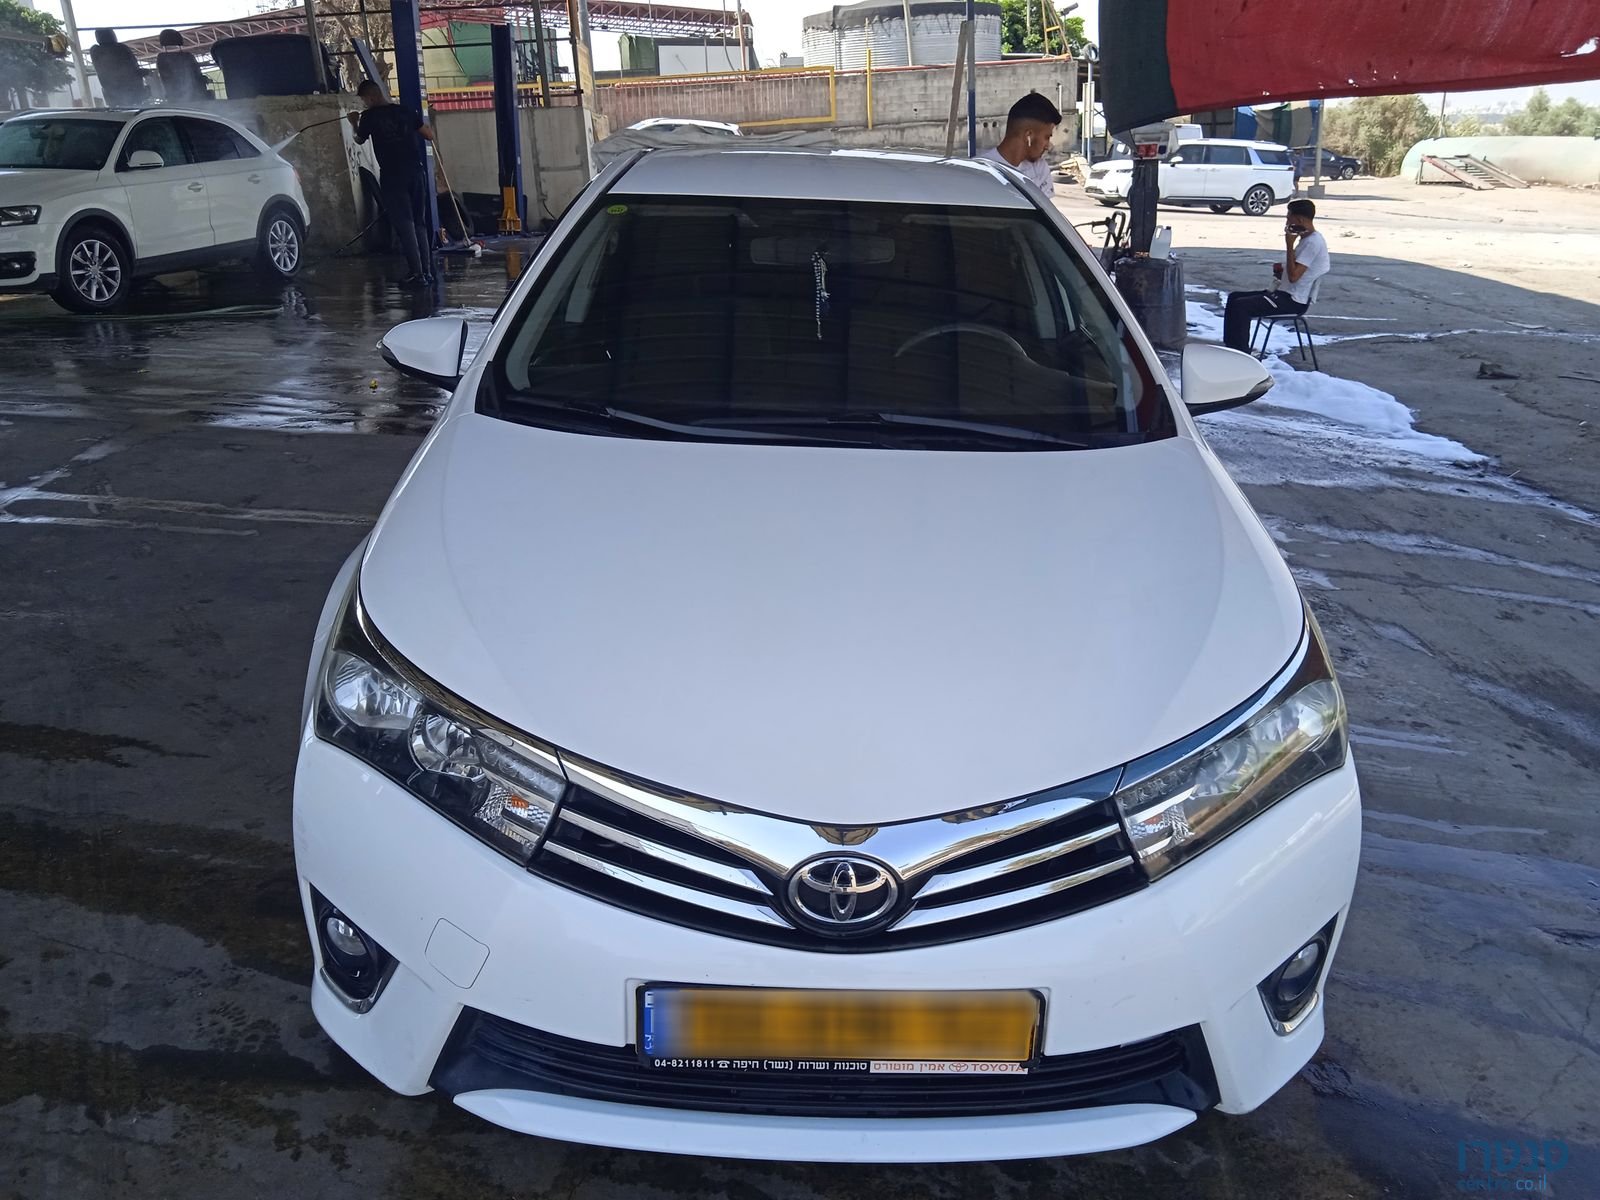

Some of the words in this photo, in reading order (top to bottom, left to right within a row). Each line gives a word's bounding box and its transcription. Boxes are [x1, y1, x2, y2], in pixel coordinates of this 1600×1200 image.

[654, 1058, 715, 1068] 04-8211811
[732, 1059, 759, 1071] חיפה
[797, 1061, 830, 1070] ושרות
[833, 1061, 868, 1071] סוכנות
[873, 1062, 914, 1071] מוטורס
[919, 1063, 945, 1073] אמין
[971, 1063, 1026, 1072] TOYOTA
